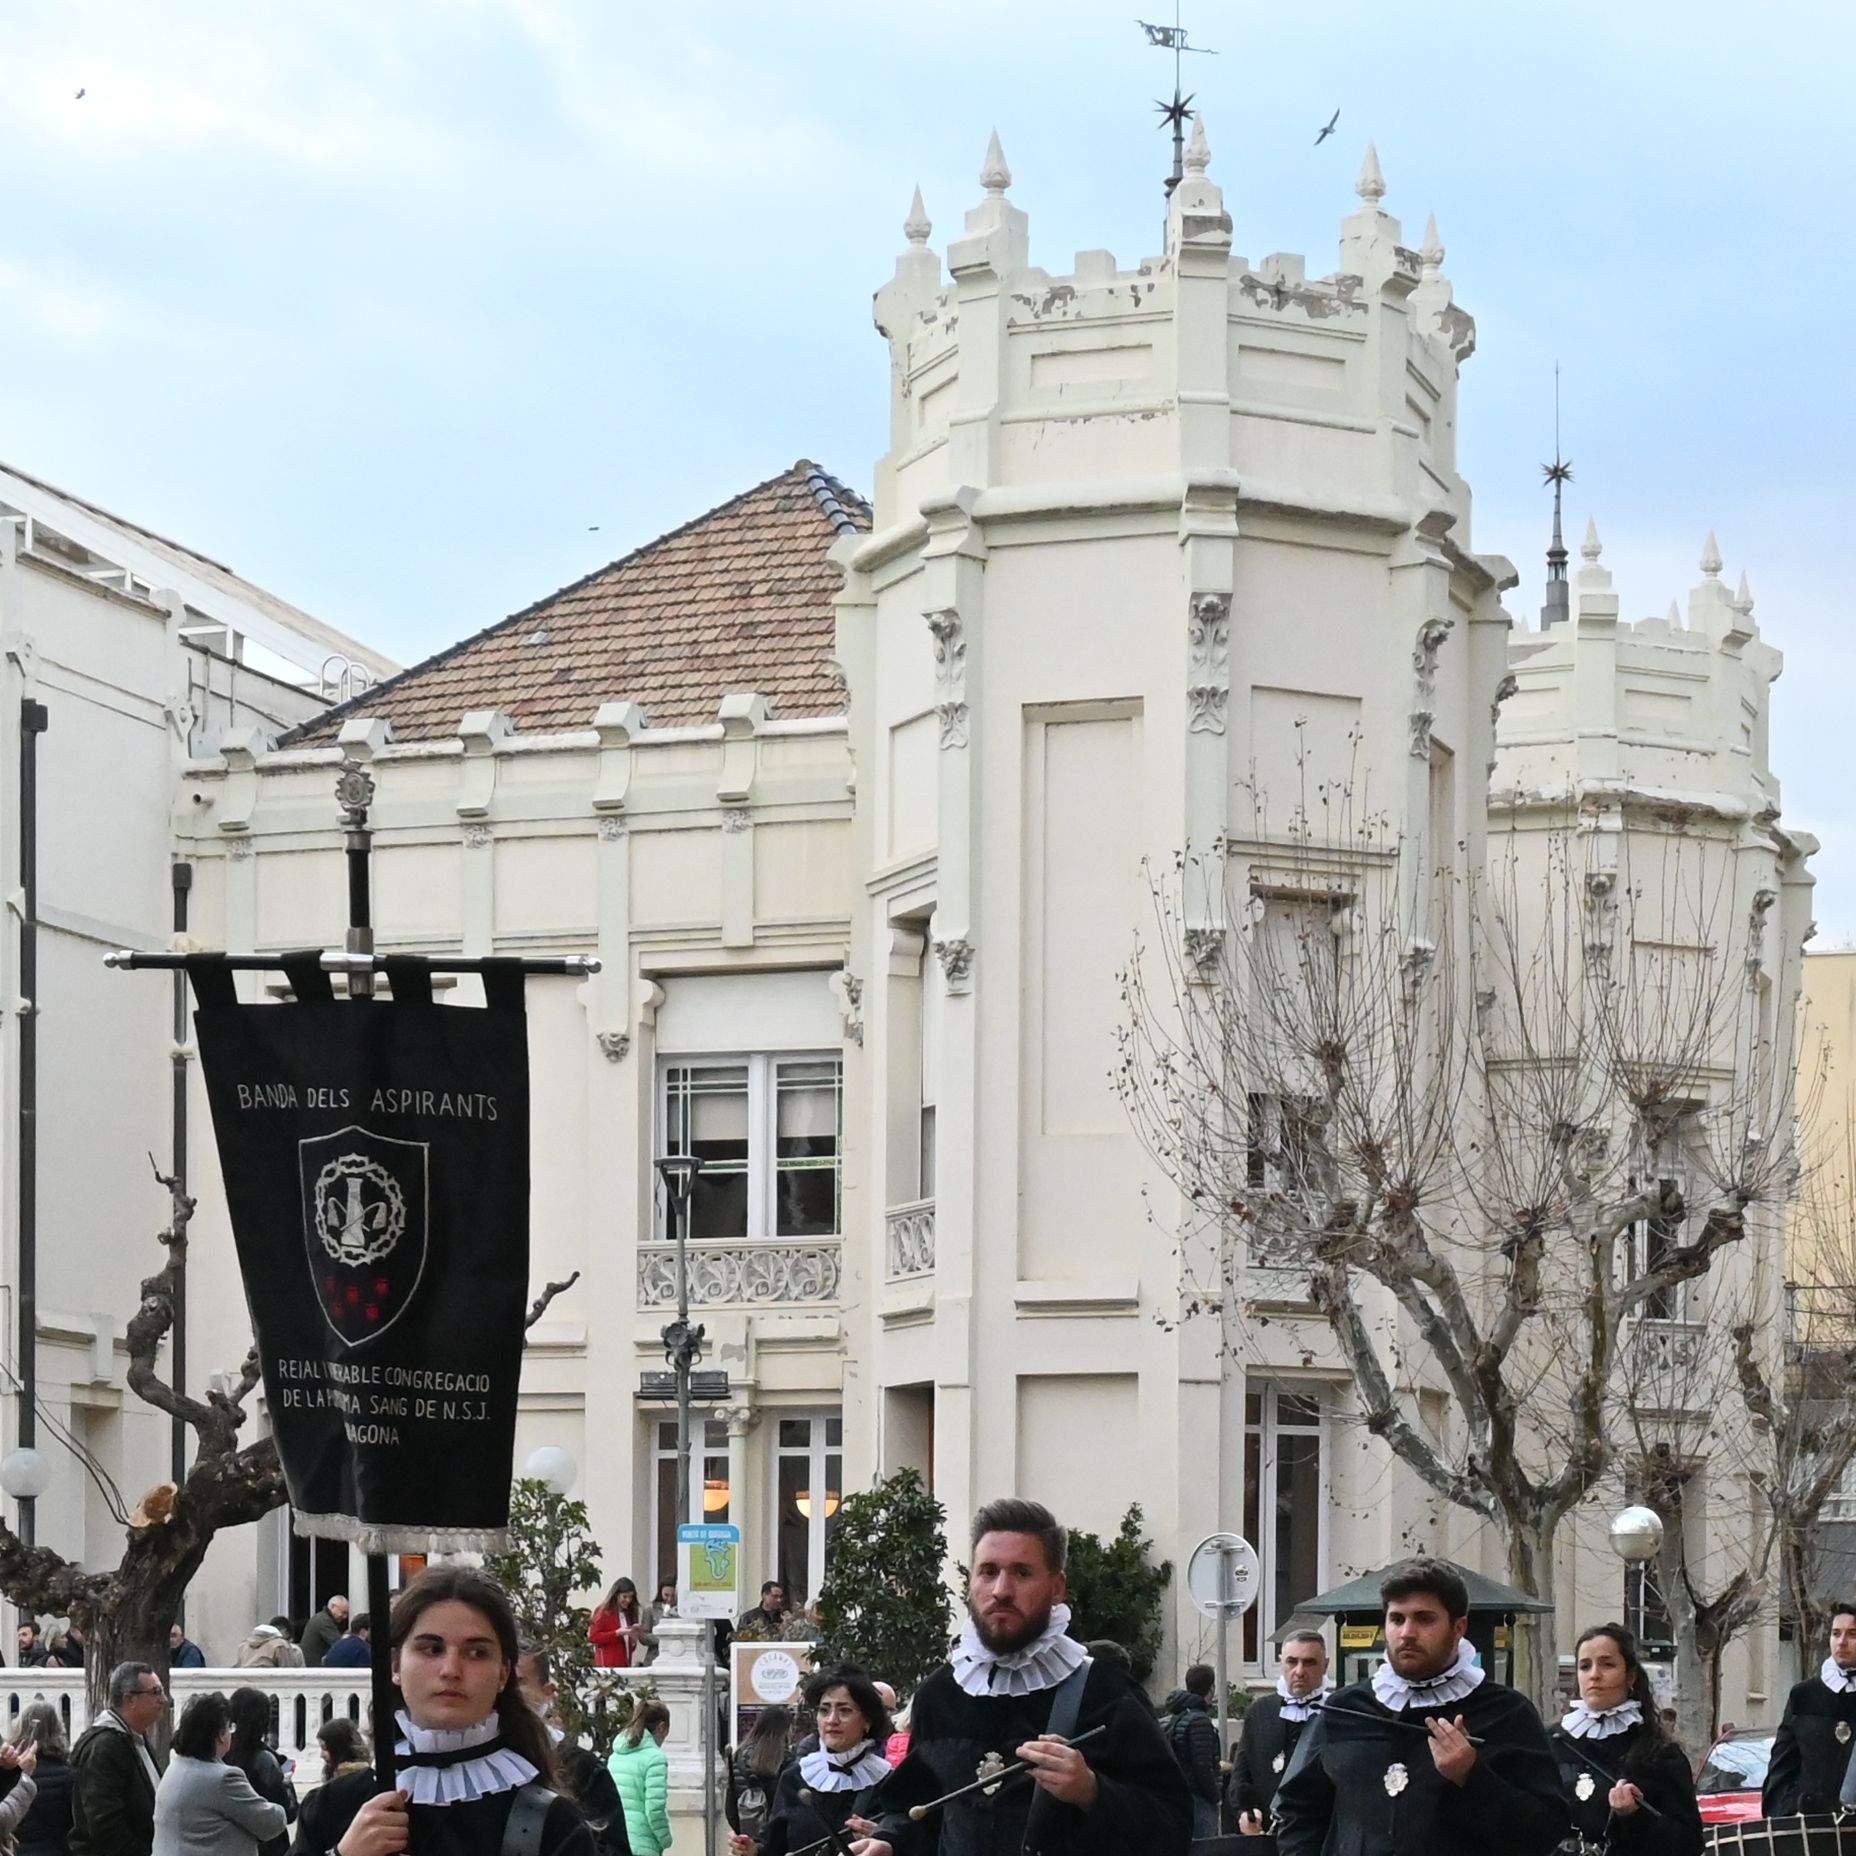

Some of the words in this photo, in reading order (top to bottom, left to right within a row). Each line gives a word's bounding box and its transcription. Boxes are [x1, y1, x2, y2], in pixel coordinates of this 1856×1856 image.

[237, 1084, 298, 1109] BANDA
[307, 1087, 350, 1109] DELS
[371, 1089, 498, 1121] ASPIRANTS
[279, 1359, 321, 1379] REIAL
[384, 1366, 490, 1392] CONGREGACIO
[283, 1388, 302, 1408] DE
[305, 1389, 325, 1408] LA
[370, 1395, 407, 1416] SANG
[415, 1398, 437, 1419] DE
[443, 1402, 491, 1420] N.S.J.
